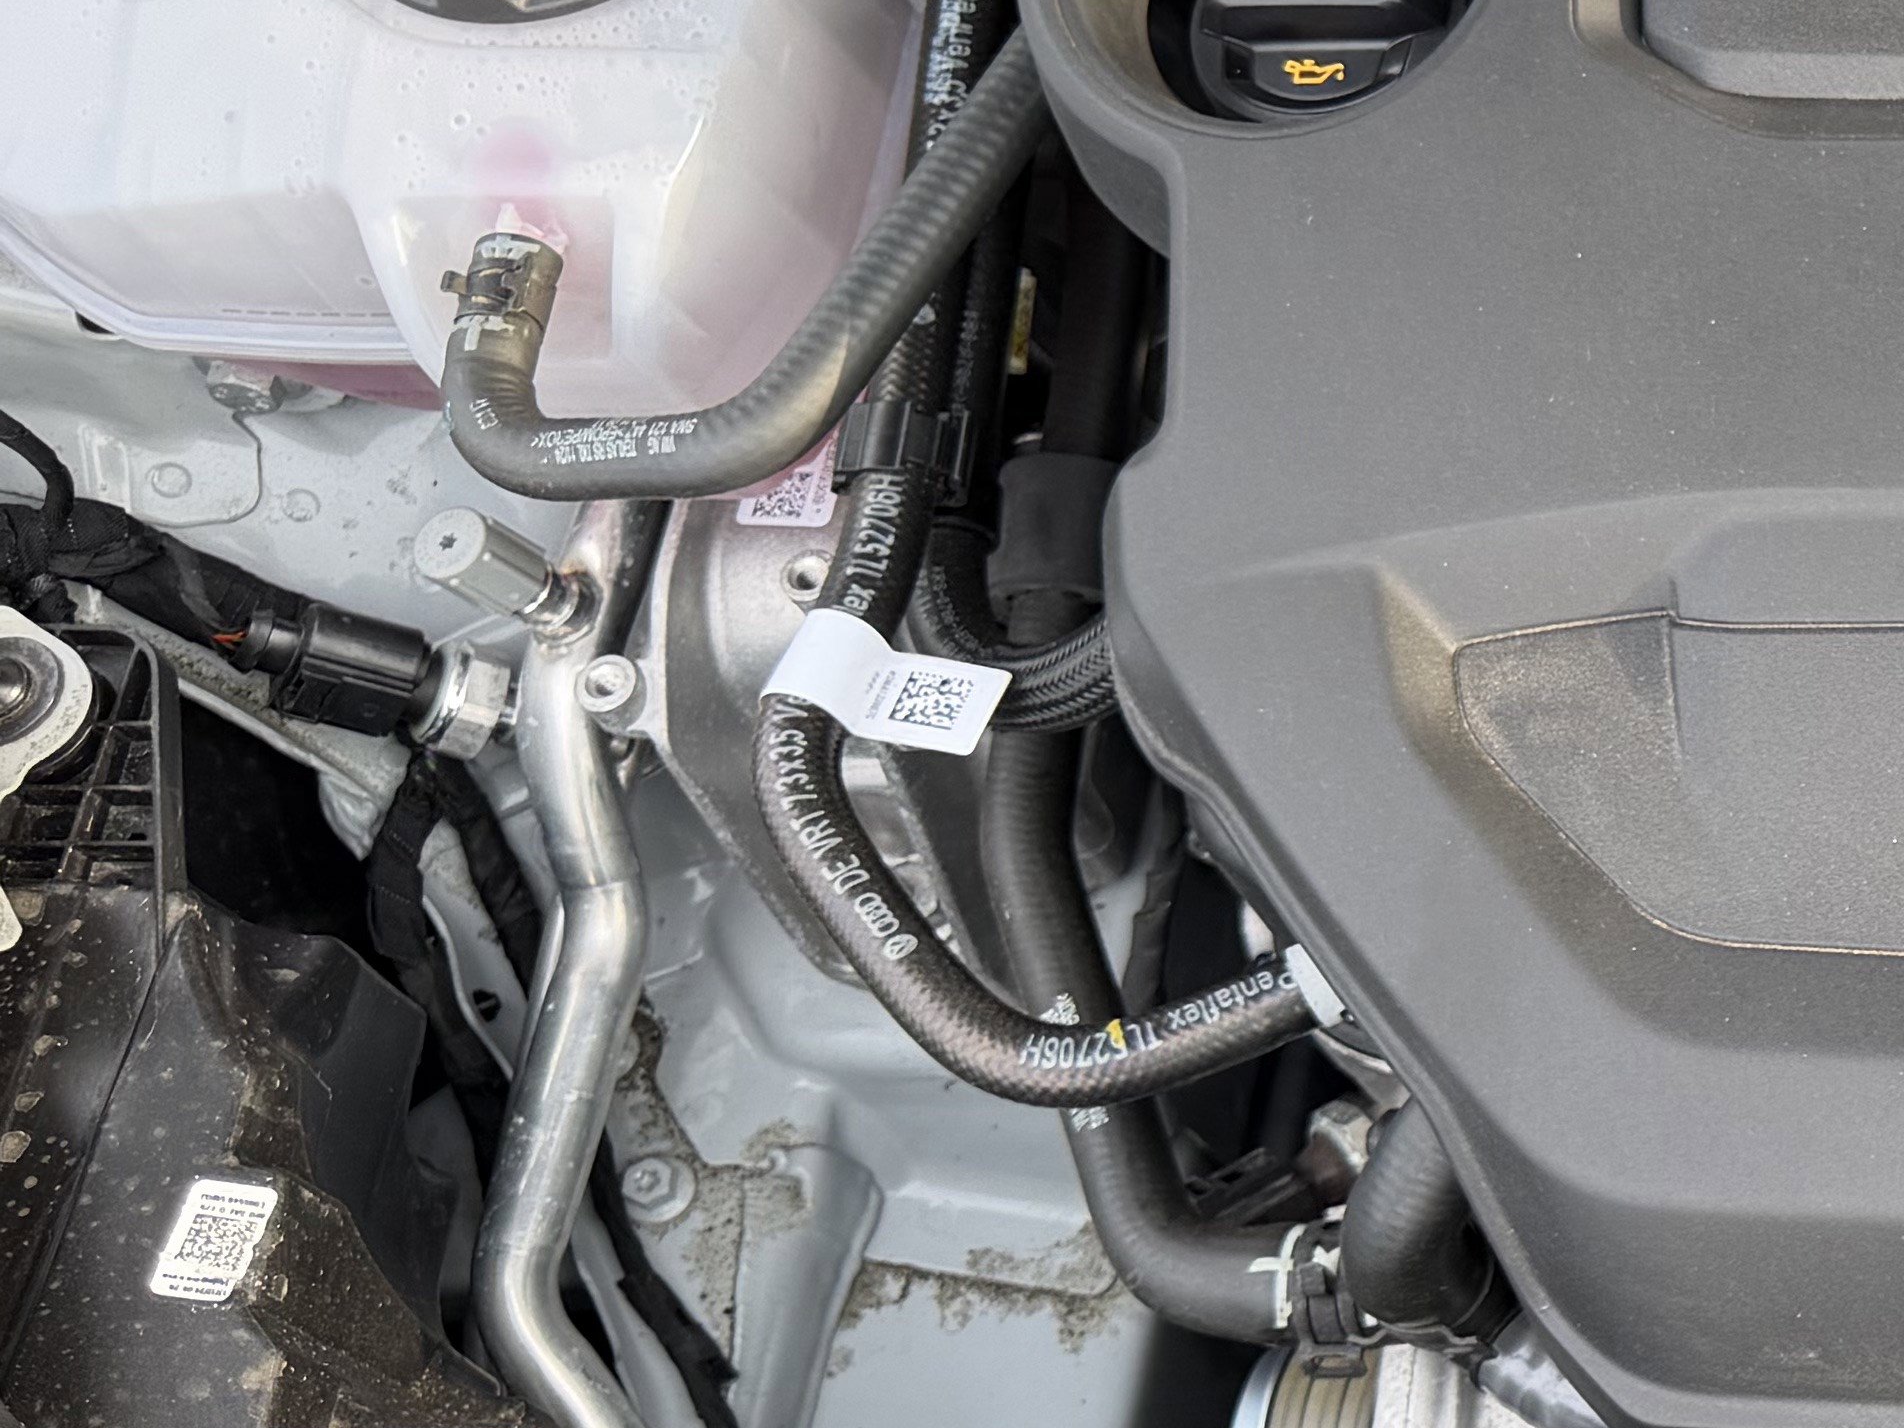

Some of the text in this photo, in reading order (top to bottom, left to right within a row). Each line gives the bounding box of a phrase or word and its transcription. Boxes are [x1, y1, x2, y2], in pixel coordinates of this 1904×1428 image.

[848, 470, 907, 578] TL52706H
[789, 801, 840, 859] VRT
[823, 856, 870, 896] DE
[1019, 971, 1299, 1069] Pentaflex TL52706H
